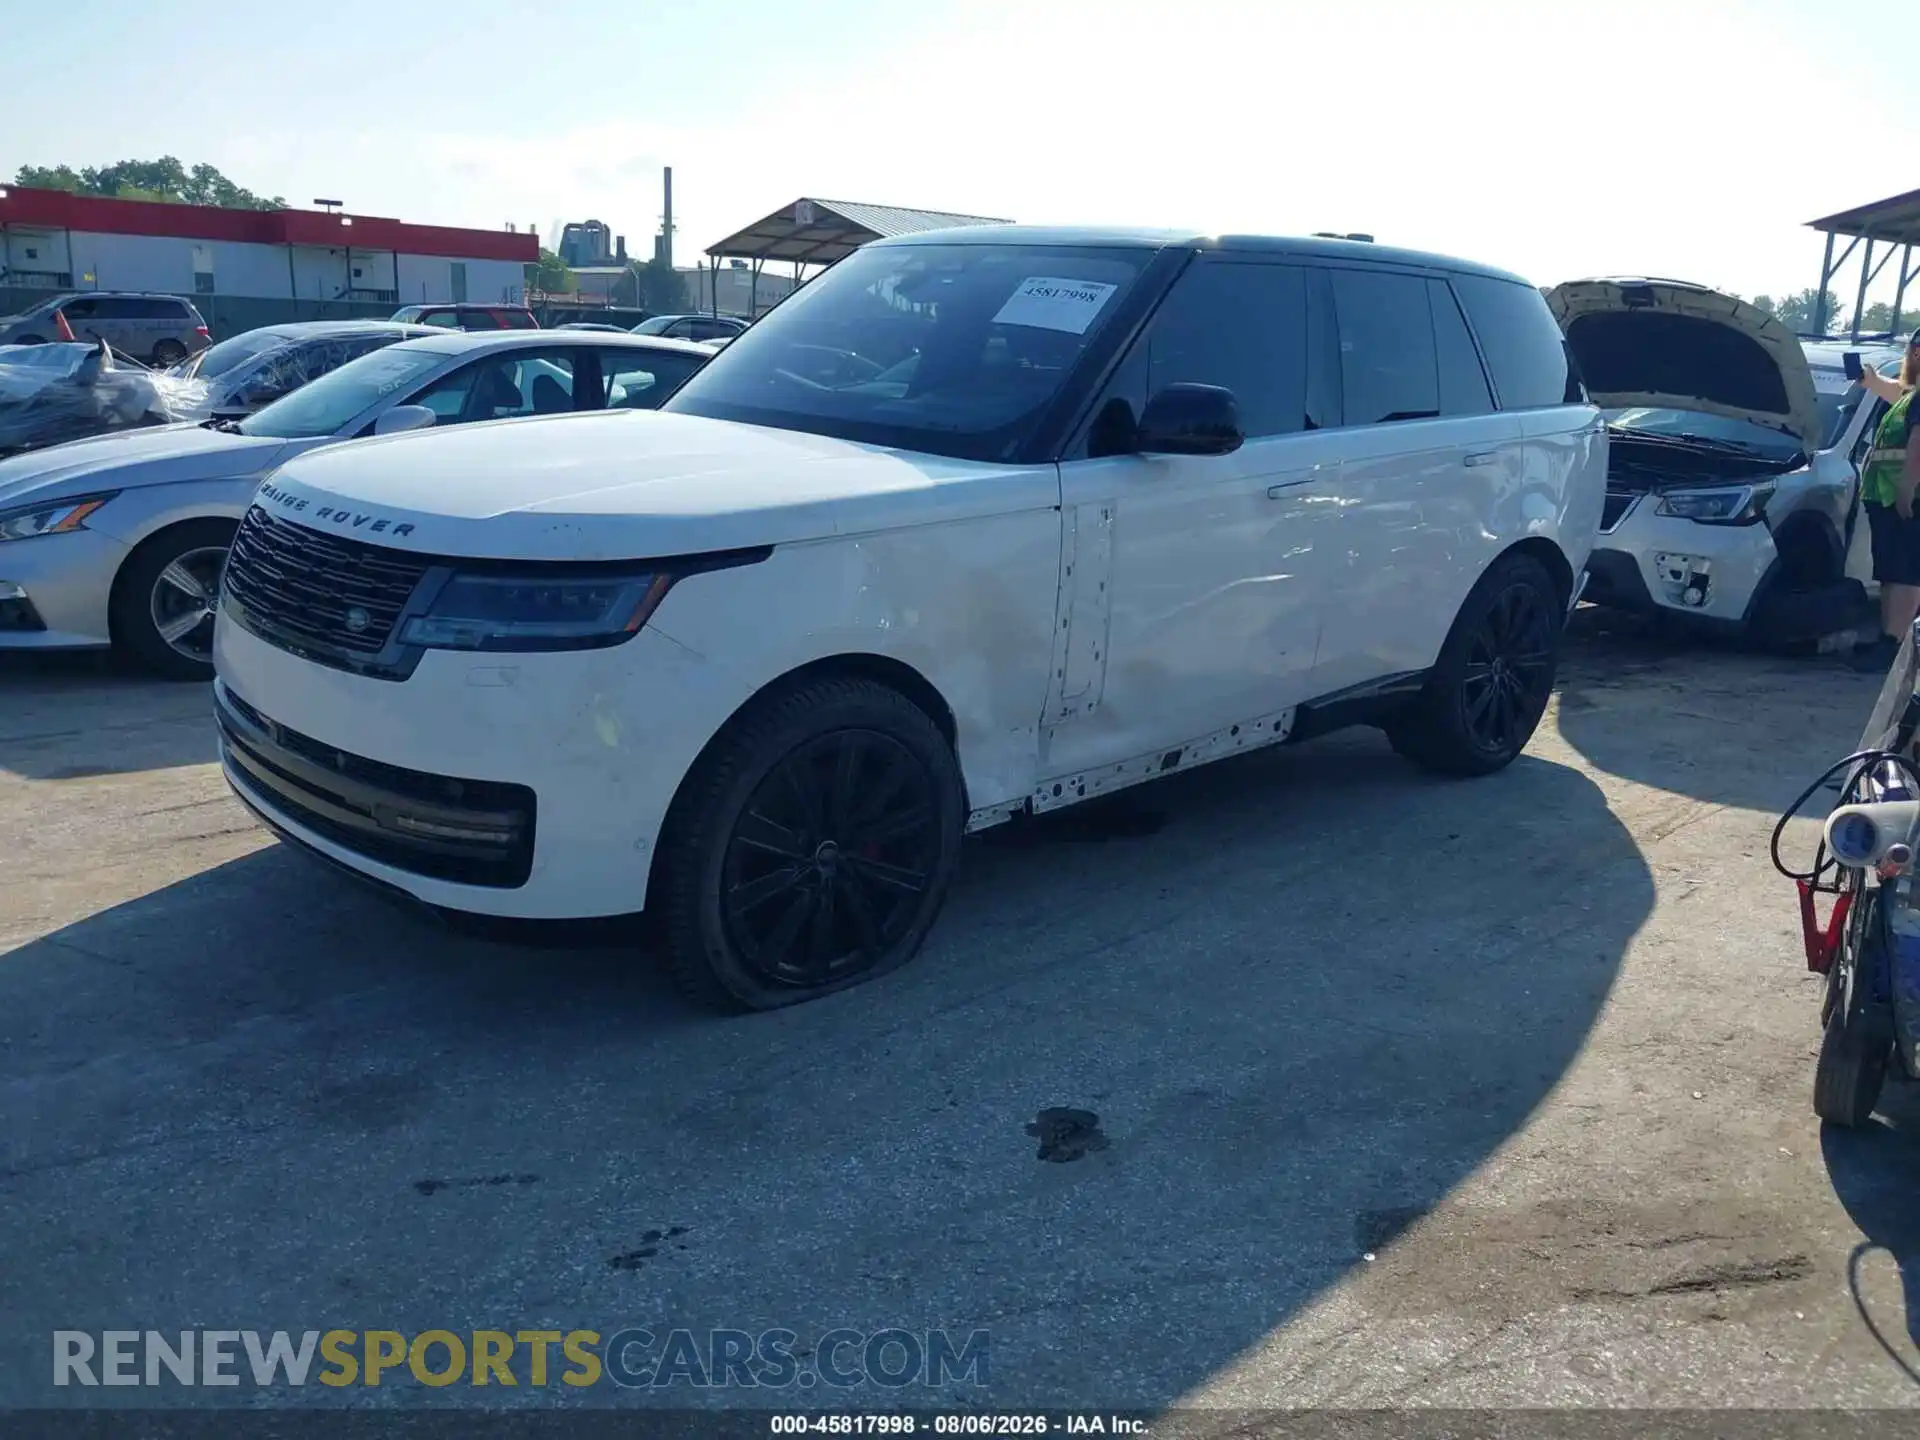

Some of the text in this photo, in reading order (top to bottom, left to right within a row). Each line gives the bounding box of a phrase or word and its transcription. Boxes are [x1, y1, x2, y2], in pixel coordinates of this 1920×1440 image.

[1024, 287, 1098, 303] 45817998
[260, 484, 415, 537] RANGE ROVER
